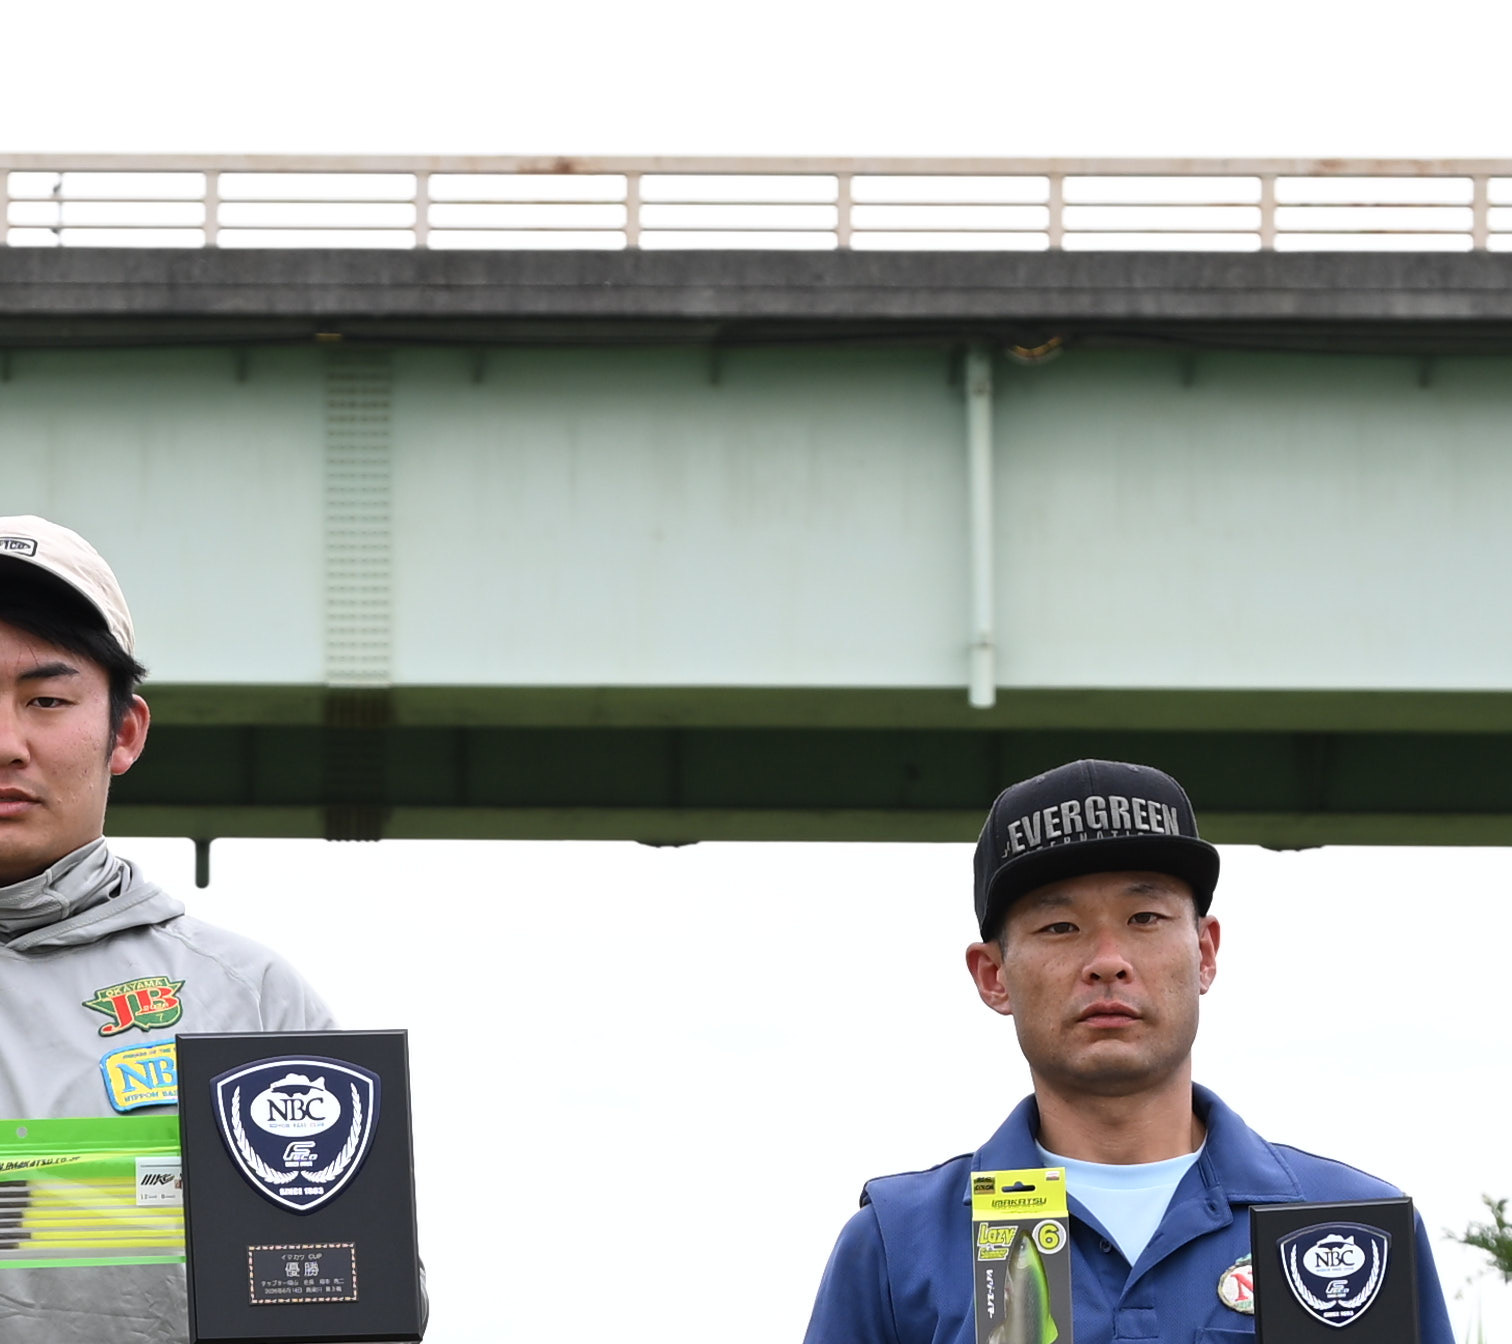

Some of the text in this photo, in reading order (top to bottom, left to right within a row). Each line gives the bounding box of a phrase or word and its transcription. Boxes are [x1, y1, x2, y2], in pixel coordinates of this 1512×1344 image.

[1007, 796, 1179, 854] EVERGREEN
[106, 981, 163, 997] OKAYAMA
[101, 987, 179, 1033] JB
[116, 1056, 177, 1093] NB
[267, 1097, 326, 1121] NBC
[979, 1224, 1017, 1245] Lazy
[1039, 1223, 1060, 1250] 6
[285, 1261, 319, 1277] 優勝
[1315, 1250, 1355, 1267] NBC
